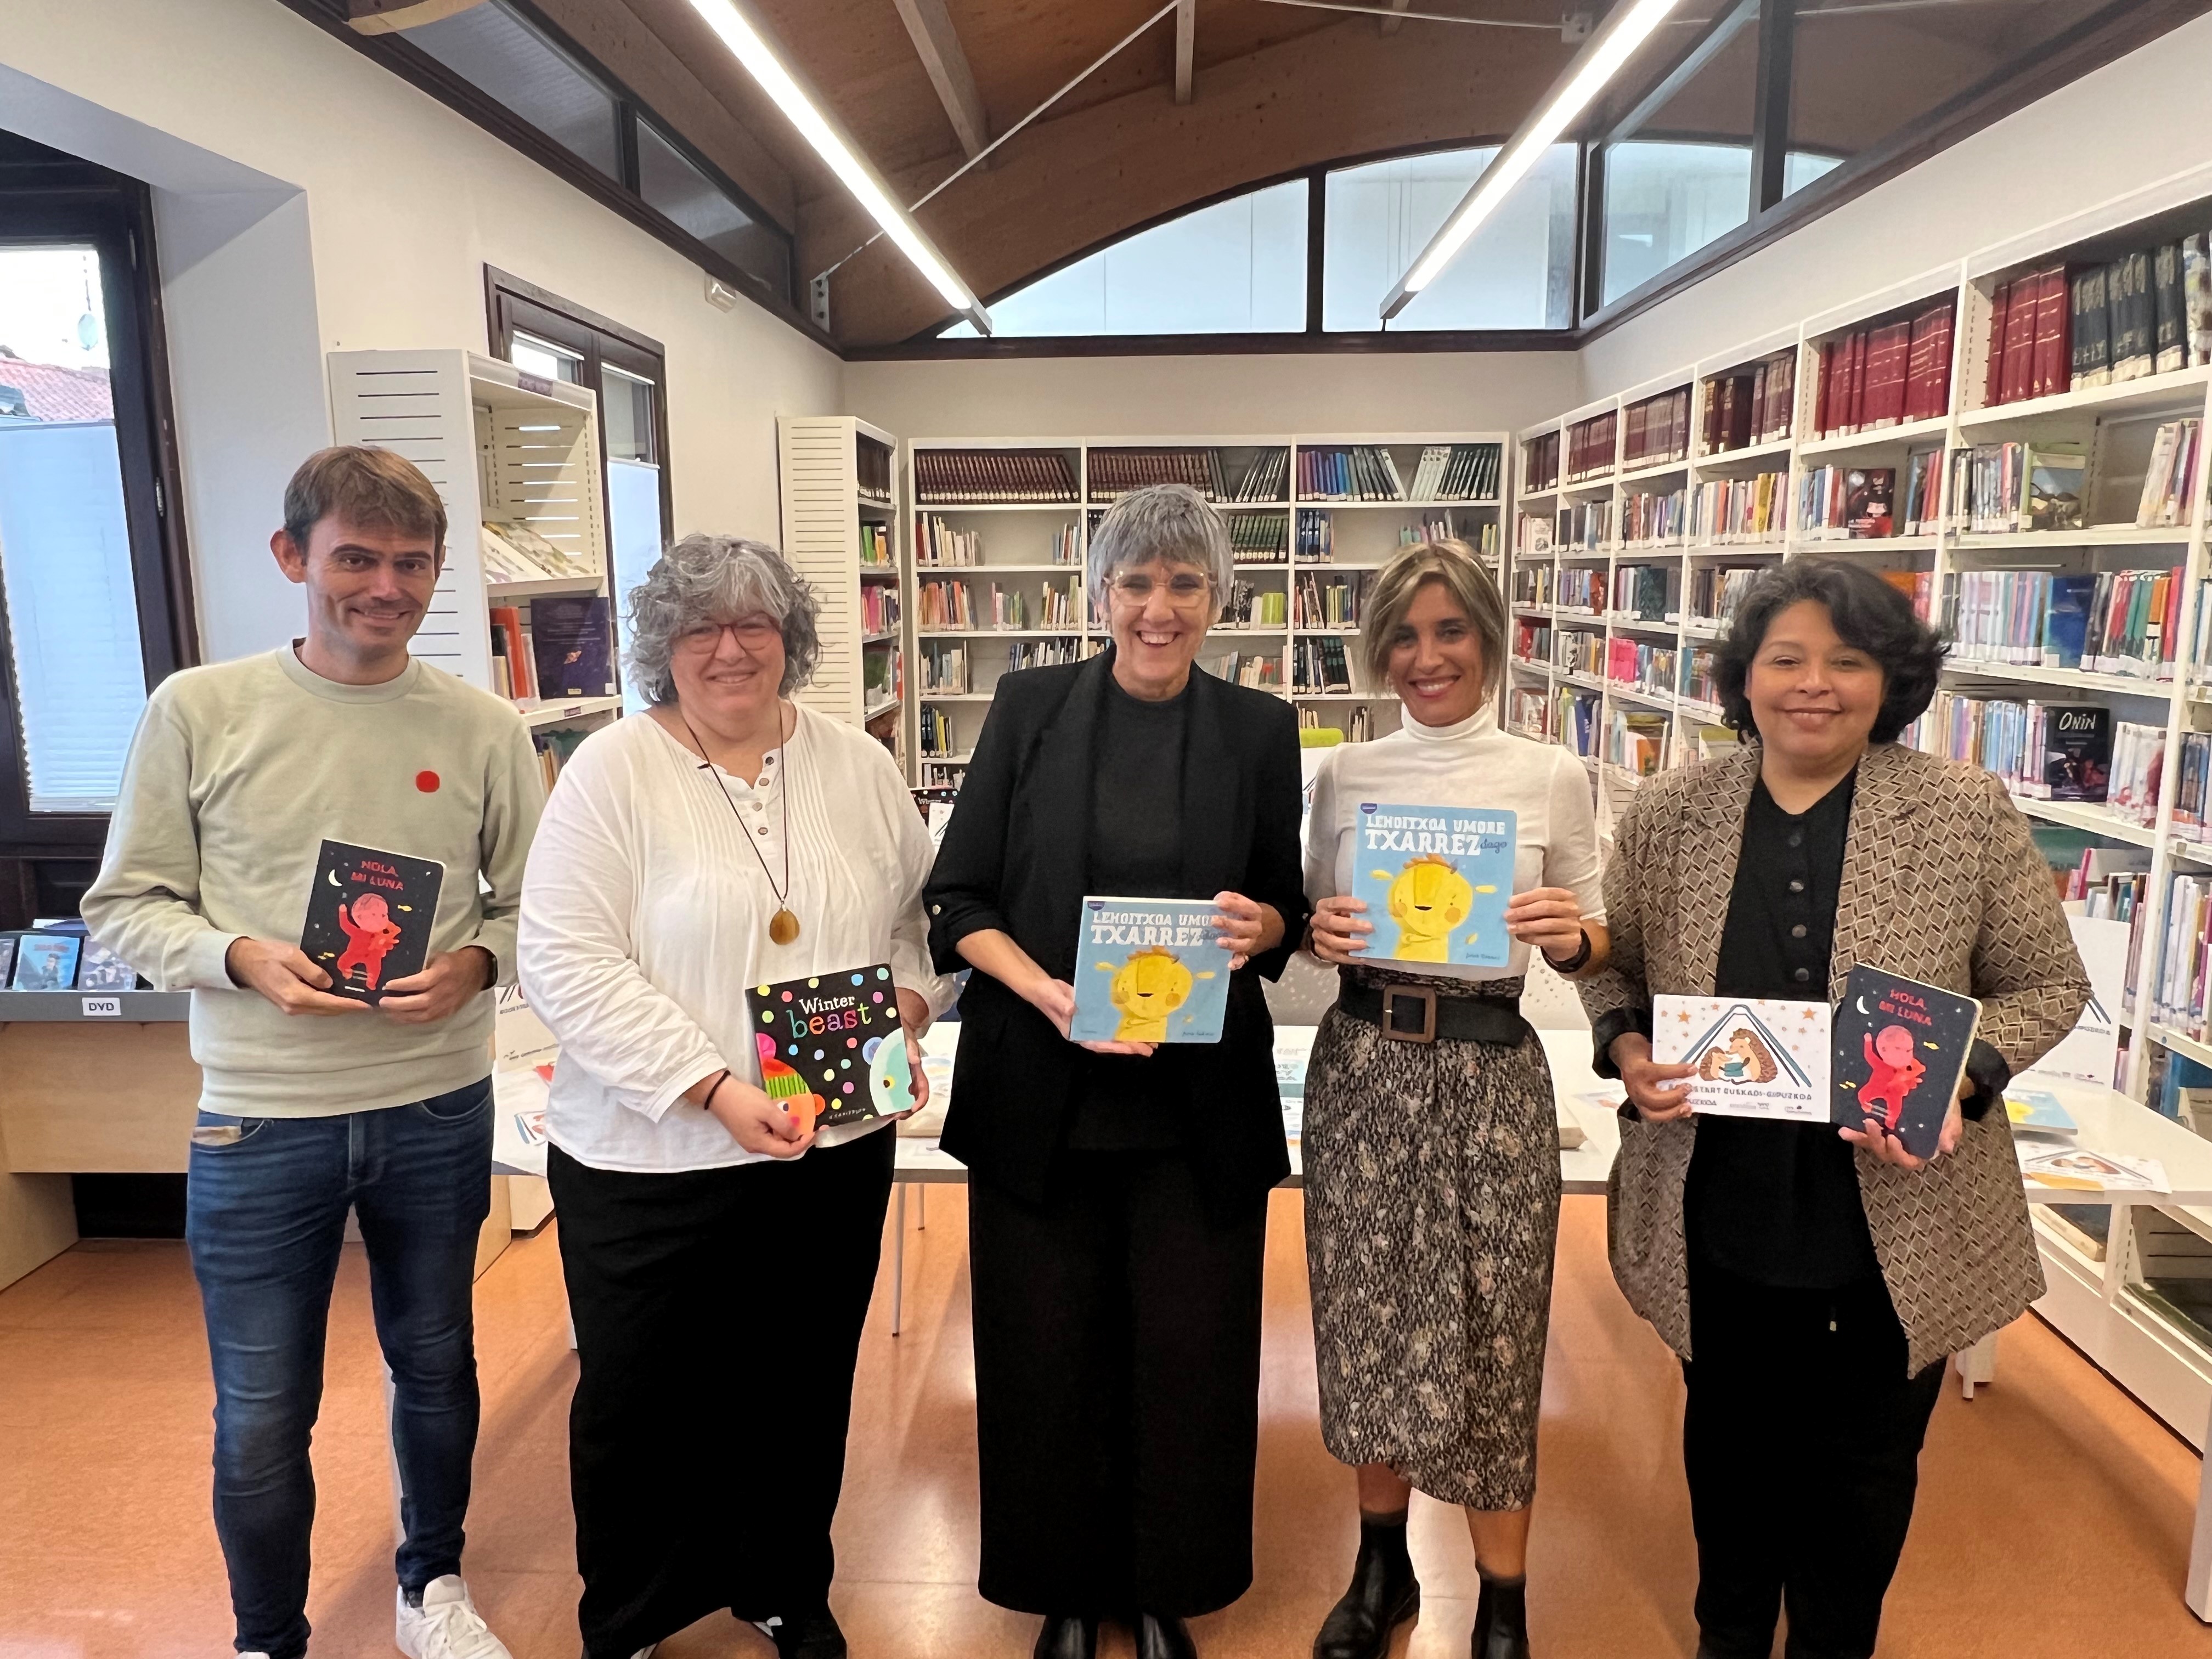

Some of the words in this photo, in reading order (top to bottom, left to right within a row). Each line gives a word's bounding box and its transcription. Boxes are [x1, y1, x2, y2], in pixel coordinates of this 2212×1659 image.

[1453, 820, 1505, 836] UMORE
[1365, 829, 1481, 856] TXARREZ
[1480, 838, 1508, 854] dago
[369, 876, 404, 891] LUNA
[1091, 925, 1204, 946] TXARREZ
[88, 1002, 115, 1012] DVD
[799, 995, 855, 1014] Winter
[786, 1002, 872, 1039] beast
[1897, 1006, 1932, 1026] LUNA
